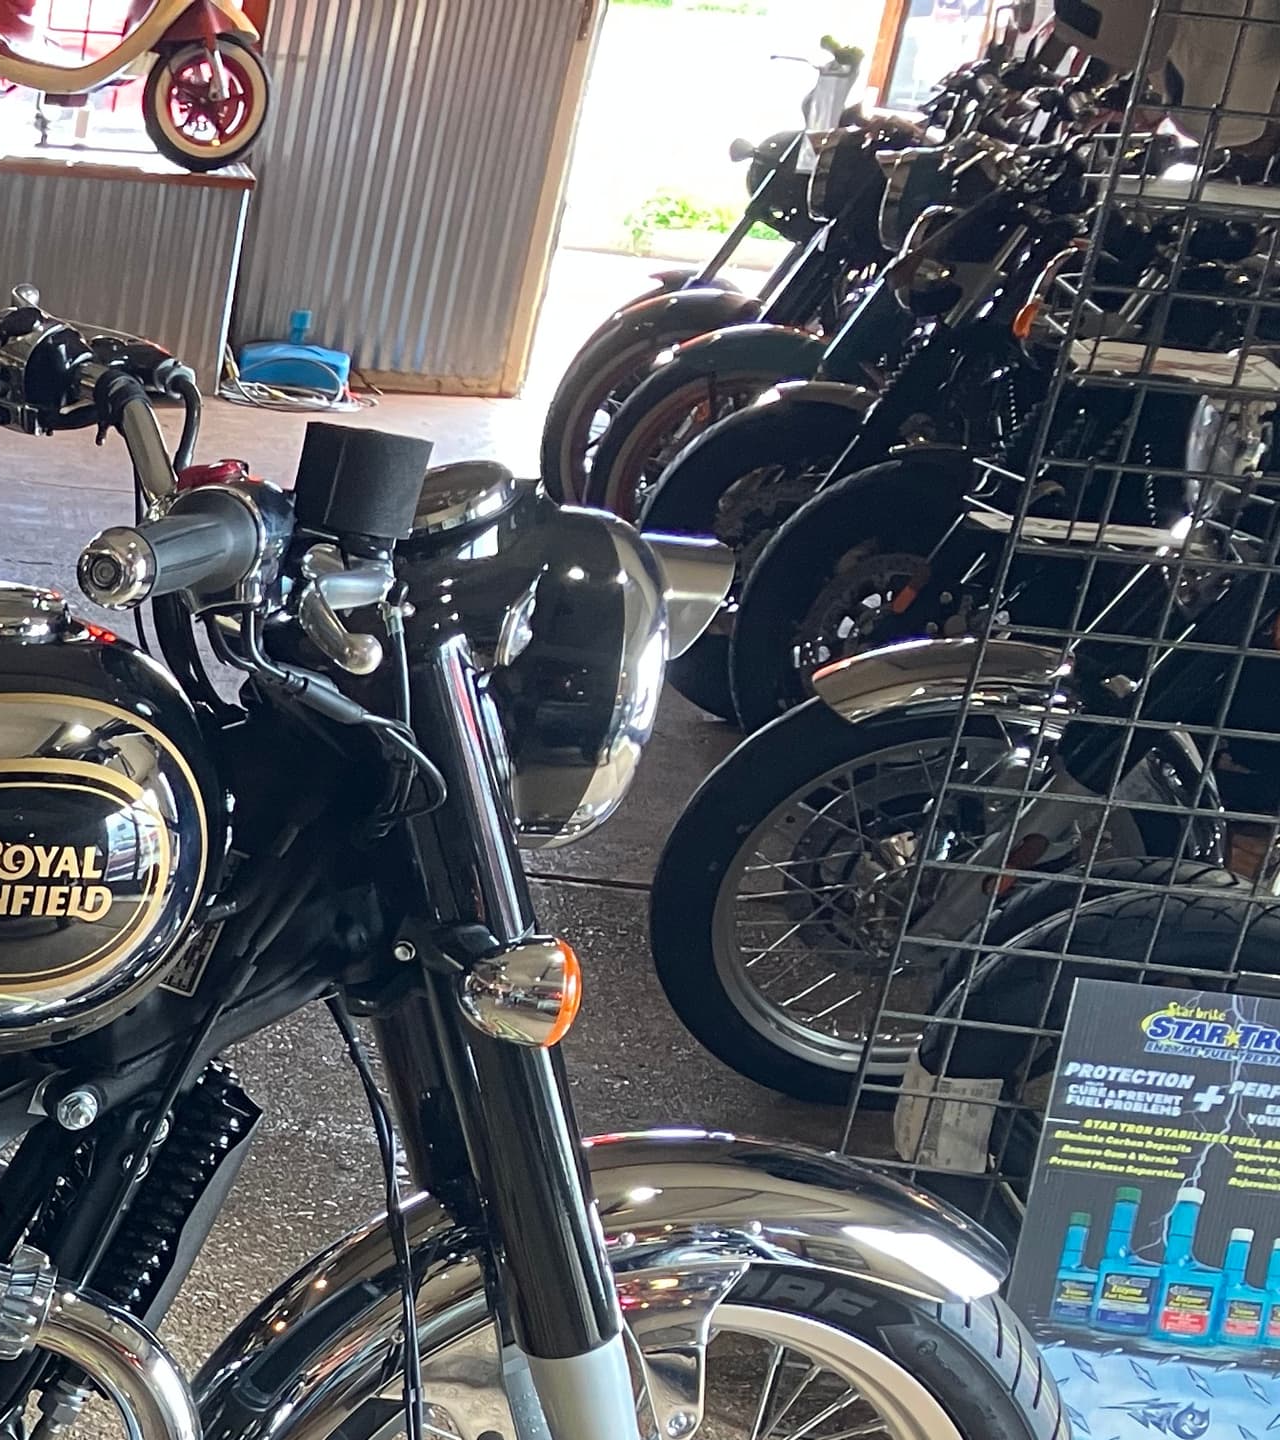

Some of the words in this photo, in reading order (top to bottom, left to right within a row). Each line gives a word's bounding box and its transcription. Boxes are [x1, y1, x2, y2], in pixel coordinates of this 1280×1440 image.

[1148, 1016, 1227, 1046] STAR
[1064, 1062, 1195, 1089] PROTECTION
[1066, 1094, 1102, 1108] FUEL
[1104, 1098, 1181, 1117] PROBLEMS
[1069, 1084, 1107, 1097] CURE
[1118, 1090, 1183, 1105] PREVENT
[1084, 1118, 1117, 1131] STAR
[1119, 1122, 1153, 1135] TRON
[1229, 1135, 1261, 1148] FUEL
